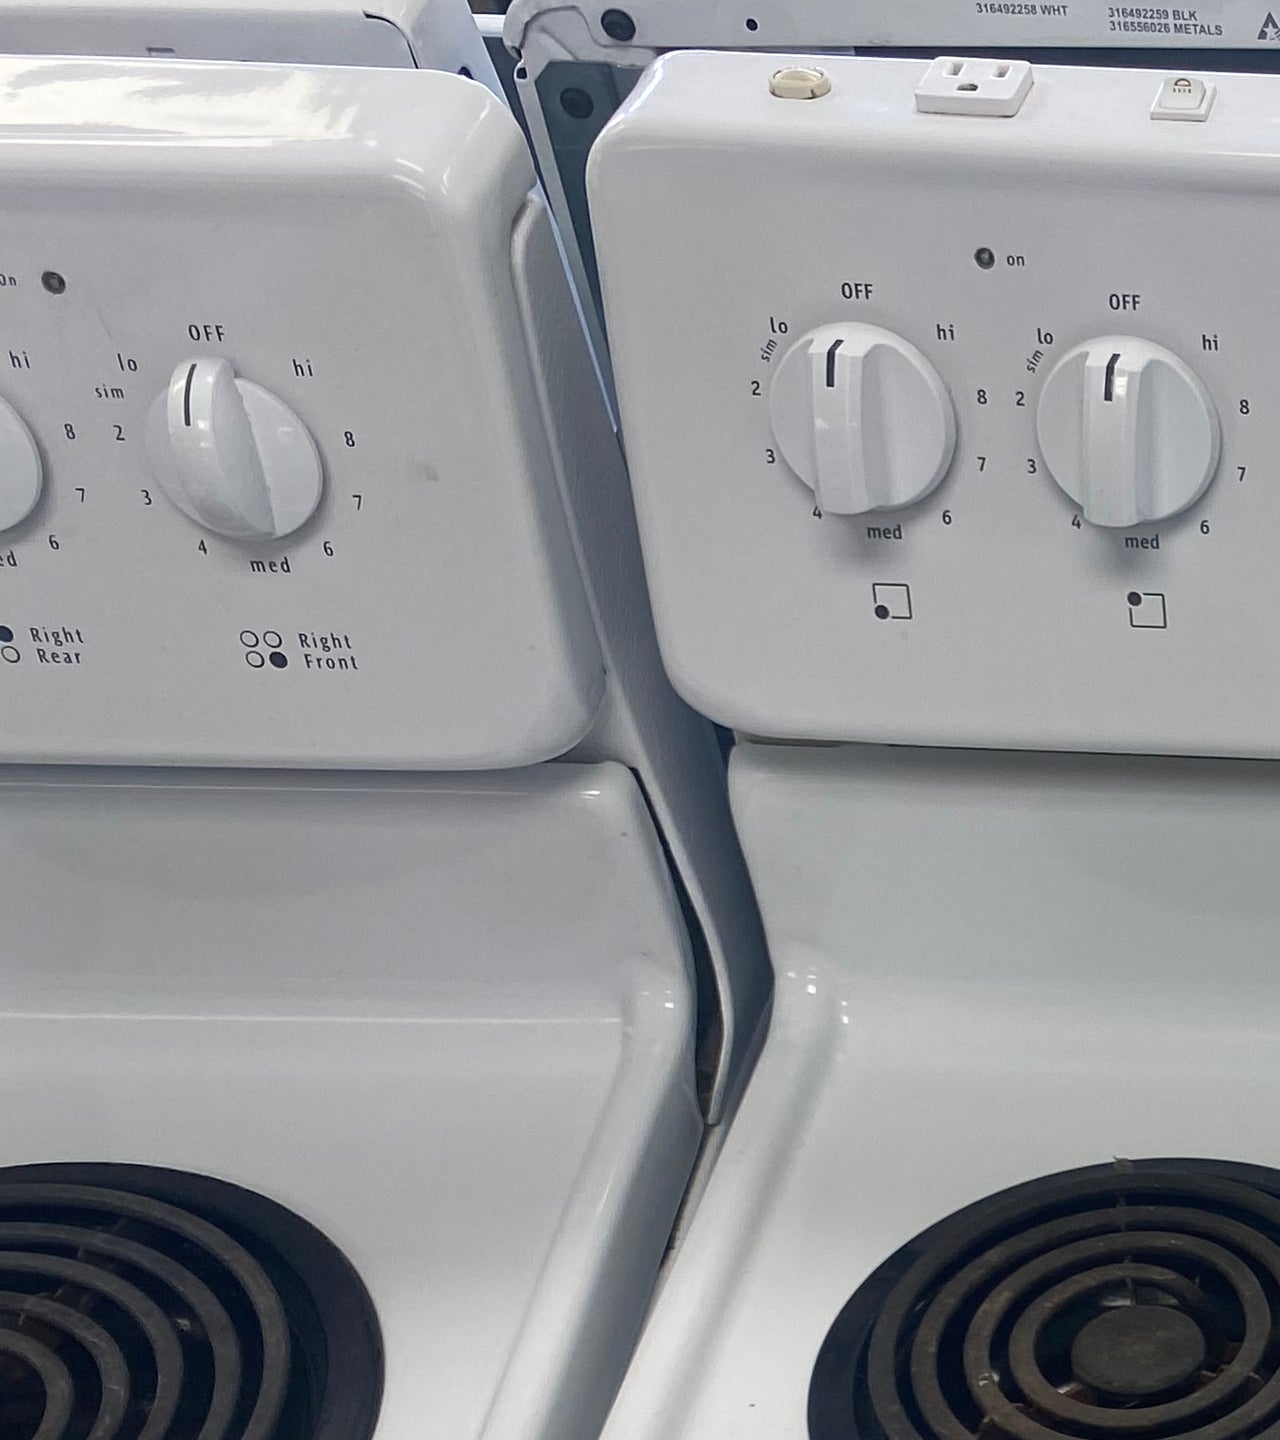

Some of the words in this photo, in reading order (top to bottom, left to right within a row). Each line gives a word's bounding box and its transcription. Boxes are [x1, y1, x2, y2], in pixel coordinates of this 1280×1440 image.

[1039, 4, 1068, 16] WHT
[1172, 9, 1198, 22] BLK
[1173, 22, 1223, 36] METALS
[1006, 255, 1025, 267] on
[841, 282, 873, 300] OFF
[1108, 293, 1141, 311] OFF
[188, 324, 224, 342] OFF
[769, 316, 788, 334] lo
[936, 323, 955, 341] hi
[1037, 327, 1054, 345] lo
[1201, 334, 1218, 352] hi
[8, 350, 31, 369] hi
[760, 339, 778, 363] sim
[117, 353, 138, 372] lo
[292, 358, 313, 377] hi
[1026, 350, 1044, 374] sim
[94, 384, 125, 399] sim
[750, 380, 762, 396] 2
[976, 388, 988, 405] 8
[1015, 390, 1025, 407] 2
[1239, 399, 1250, 415] 8
[63, 423, 76, 440] 8
[113, 424, 126, 441] 2
[344, 430, 356, 448] 8
[765, 448, 776, 464] 3
[976, 456, 986, 472] 7
[1027, 458, 1037, 474] 3
[1237, 466, 1246, 482] 7
[75, 487, 85, 503] 7
[140, 489, 152, 506] 3
[352, 494, 362, 511] 7
[812, 505, 823, 520] 4
[942, 509, 952, 526] 6
[1071, 514, 1082, 530] 4
[1200, 519, 1210, 535] 6
[866, 523, 903, 540] med
[48, 534, 60, 550] 6
[198, 539, 207, 555] 4
[323, 540, 334, 557] 6
[1124, 533, 1160, 550] med
[249, 556, 291, 573] med
[29, 626, 84, 647] Right
[298, 632, 352, 653] Right
[36, 647, 81, 664] Rear
[303, 653, 358, 670] Front
